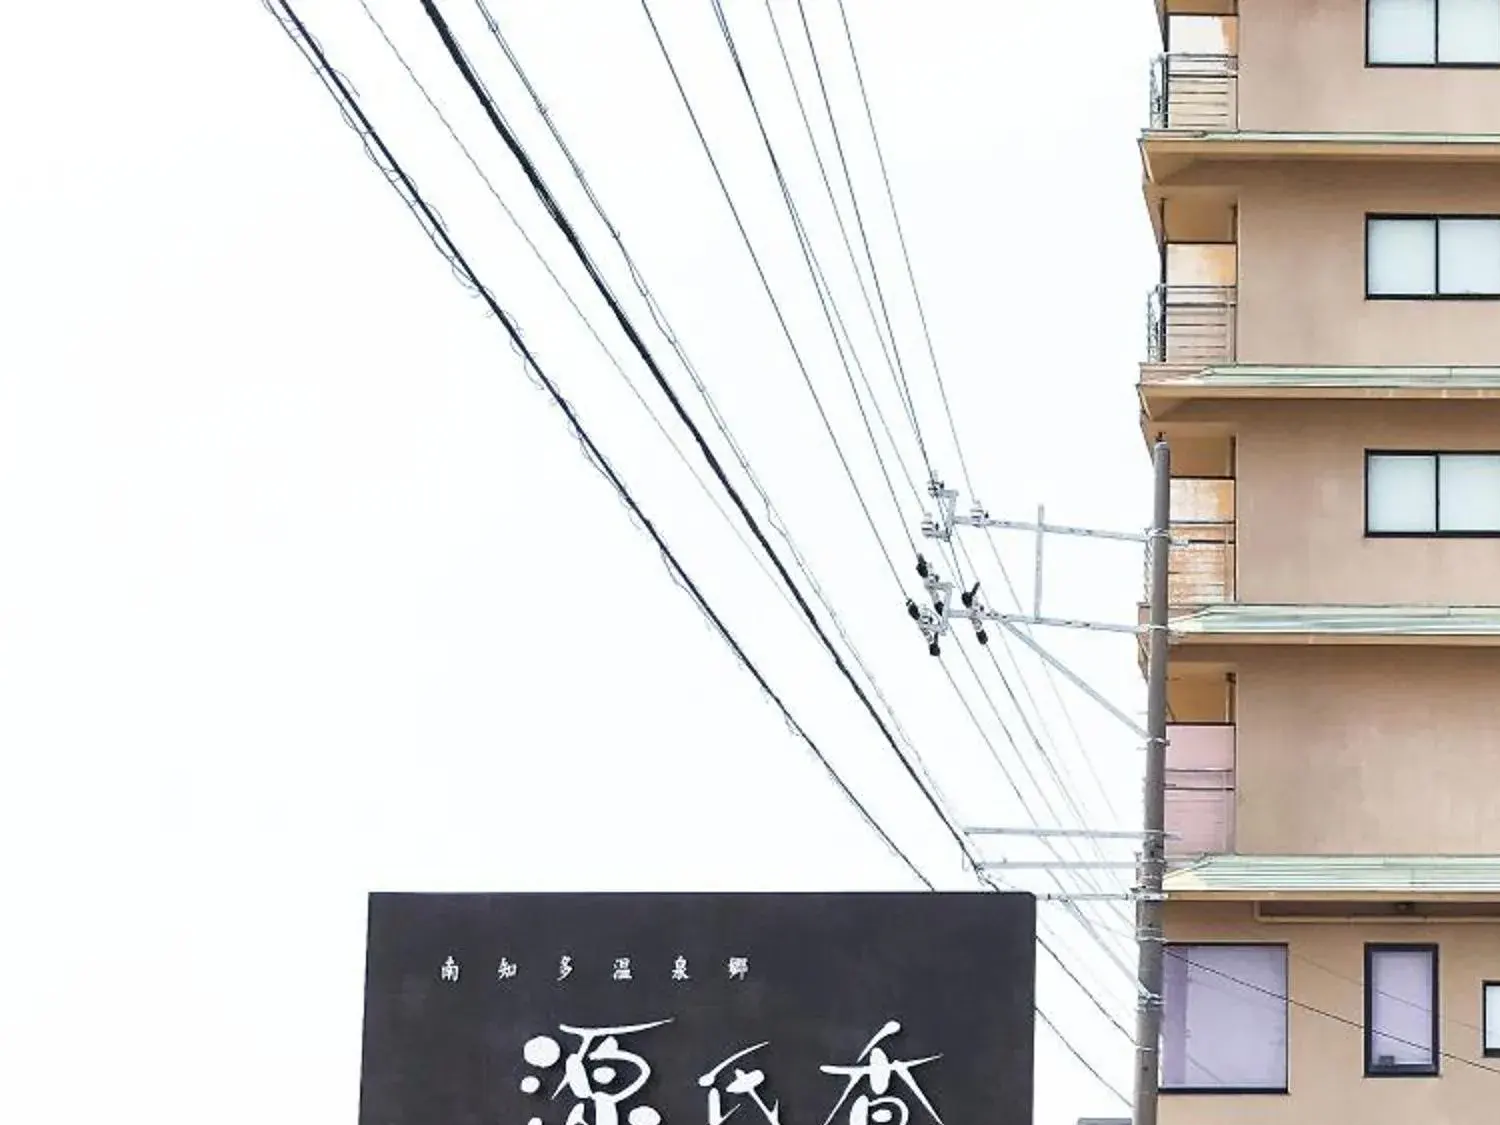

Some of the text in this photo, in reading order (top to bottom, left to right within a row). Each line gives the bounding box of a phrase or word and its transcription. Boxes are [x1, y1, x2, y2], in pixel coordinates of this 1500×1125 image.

[441, 955, 749, 982] 南知多温泉郷
